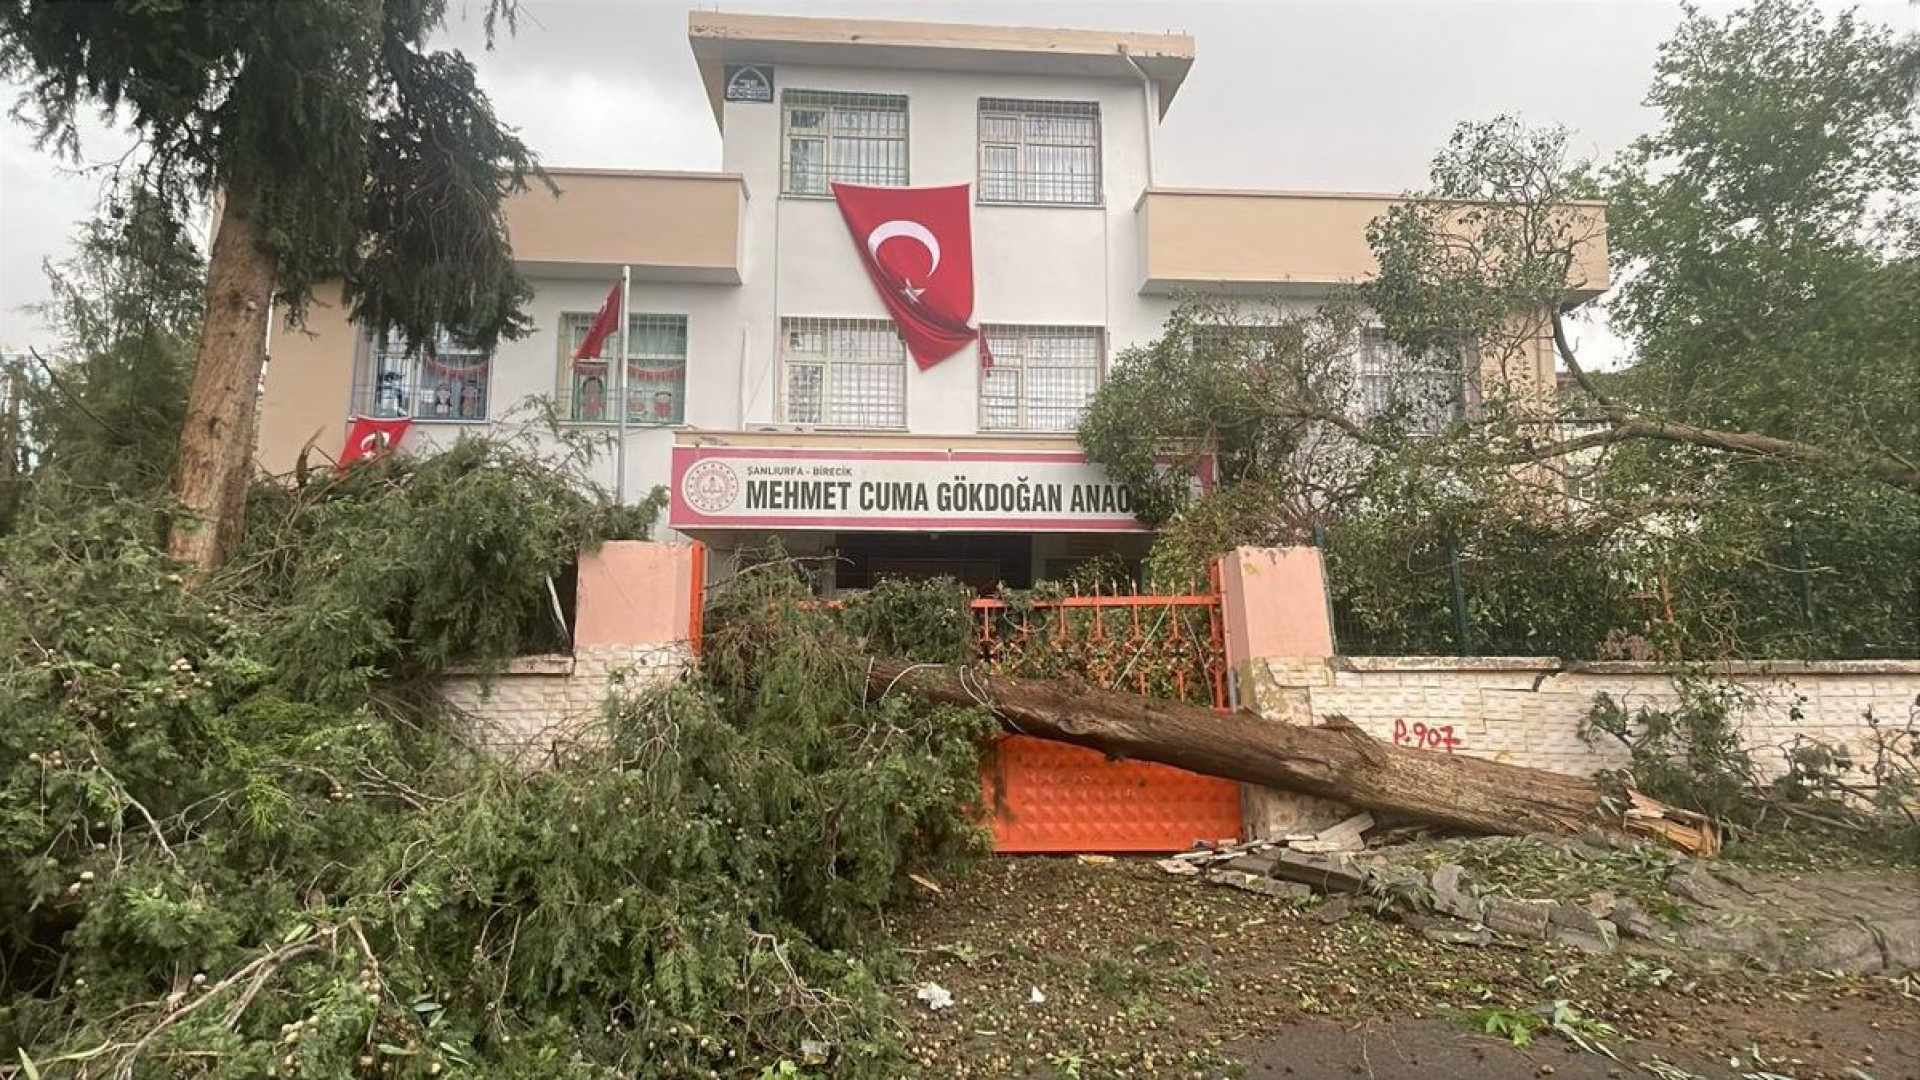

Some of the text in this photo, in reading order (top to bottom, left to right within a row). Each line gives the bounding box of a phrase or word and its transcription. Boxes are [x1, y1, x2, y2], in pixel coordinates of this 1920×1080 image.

[812, 465, 853, 477] BİRECİK
[745, 479, 852, 511] MEHMET
[859, 481, 929, 512] CUMA
[936, 474, 1063, 513] GÖKDOĞAN
[1069, 484, 1137, 514] ANAO
